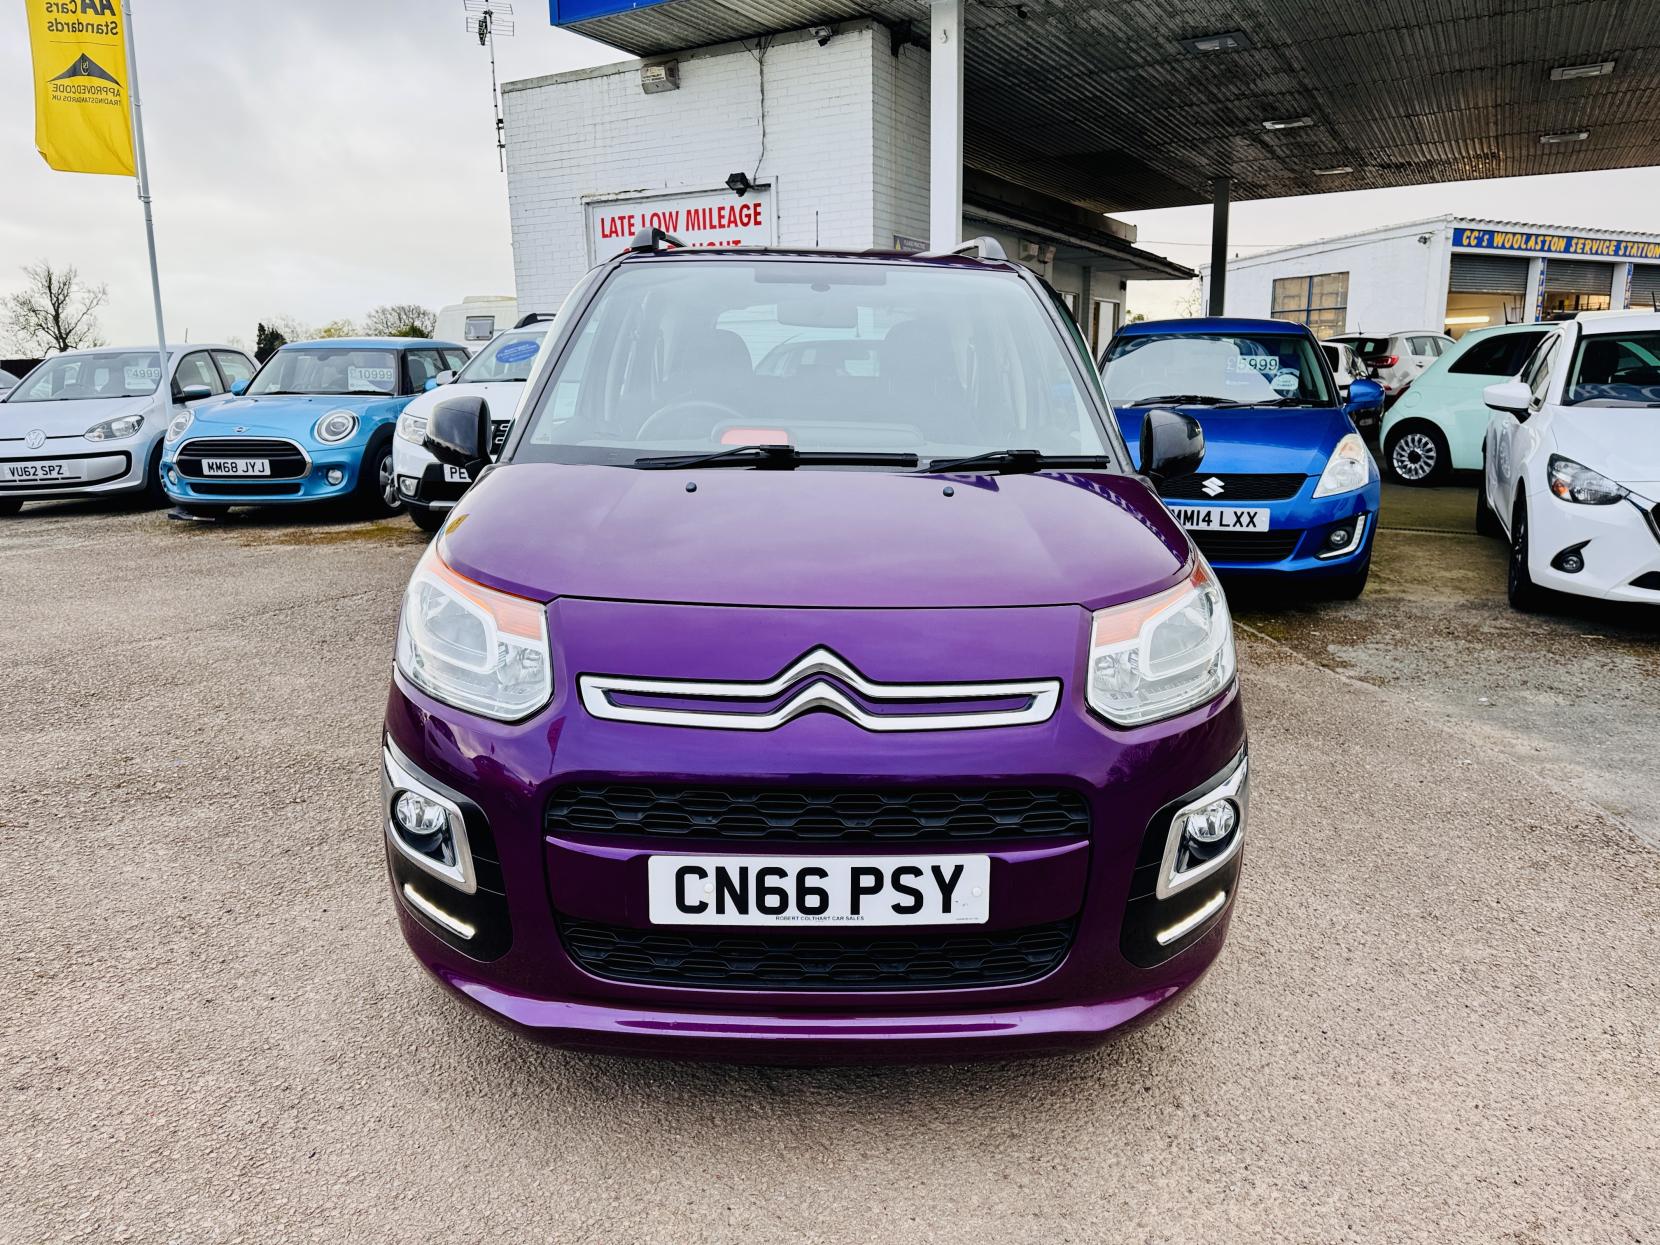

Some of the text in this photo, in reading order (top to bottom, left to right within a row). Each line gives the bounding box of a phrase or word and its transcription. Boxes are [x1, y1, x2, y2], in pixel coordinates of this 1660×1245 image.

[600, 202, 762, 239] LATE LOW MILEAGE
[1493, 232, 1566, 252] WOOLASTON
[1570, 238, 1617, 256] SERVICE
[1618, 241, 1660, 259] STATION
[8, 464, 64, 477] VU62 SPZ
[207, 461, 266, 473] MM68 JYJ
[449, 466, 467, 480] PE
[1219, 510, 1258, 528] LXX
[675, 864, 965, 916] CN66 PSY
